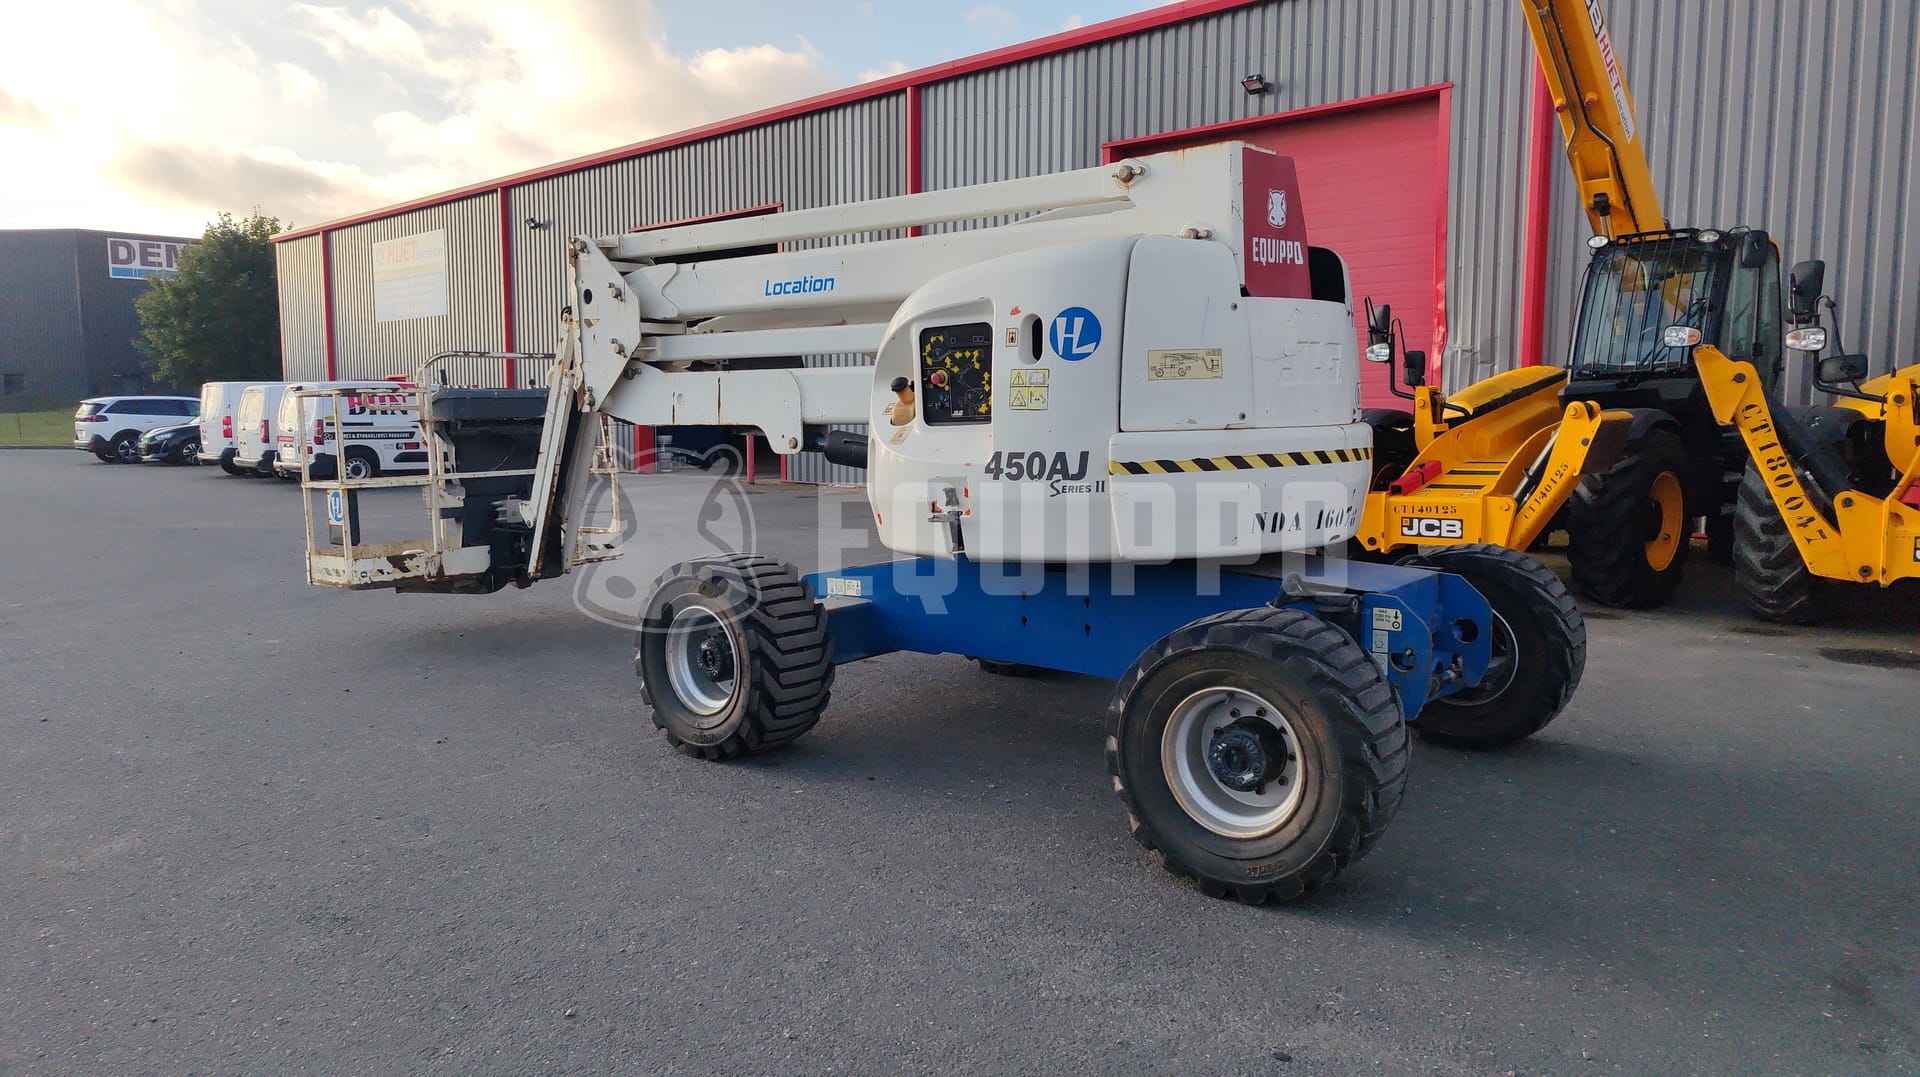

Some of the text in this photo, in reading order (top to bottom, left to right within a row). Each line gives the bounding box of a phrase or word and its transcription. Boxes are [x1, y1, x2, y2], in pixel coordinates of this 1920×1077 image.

[1599, 33, 1622, 91] HUET
[1253, 237, 1304, 267] EQUIPPO
[765, 275, 835, 297] Location
[984, 451, 1090, 481] 450AJ
[1393, 505, 1457, 514] CT140125
[1251, 511, 1302, 534] NDA
[1402, 518, 1462, 538] JCB
